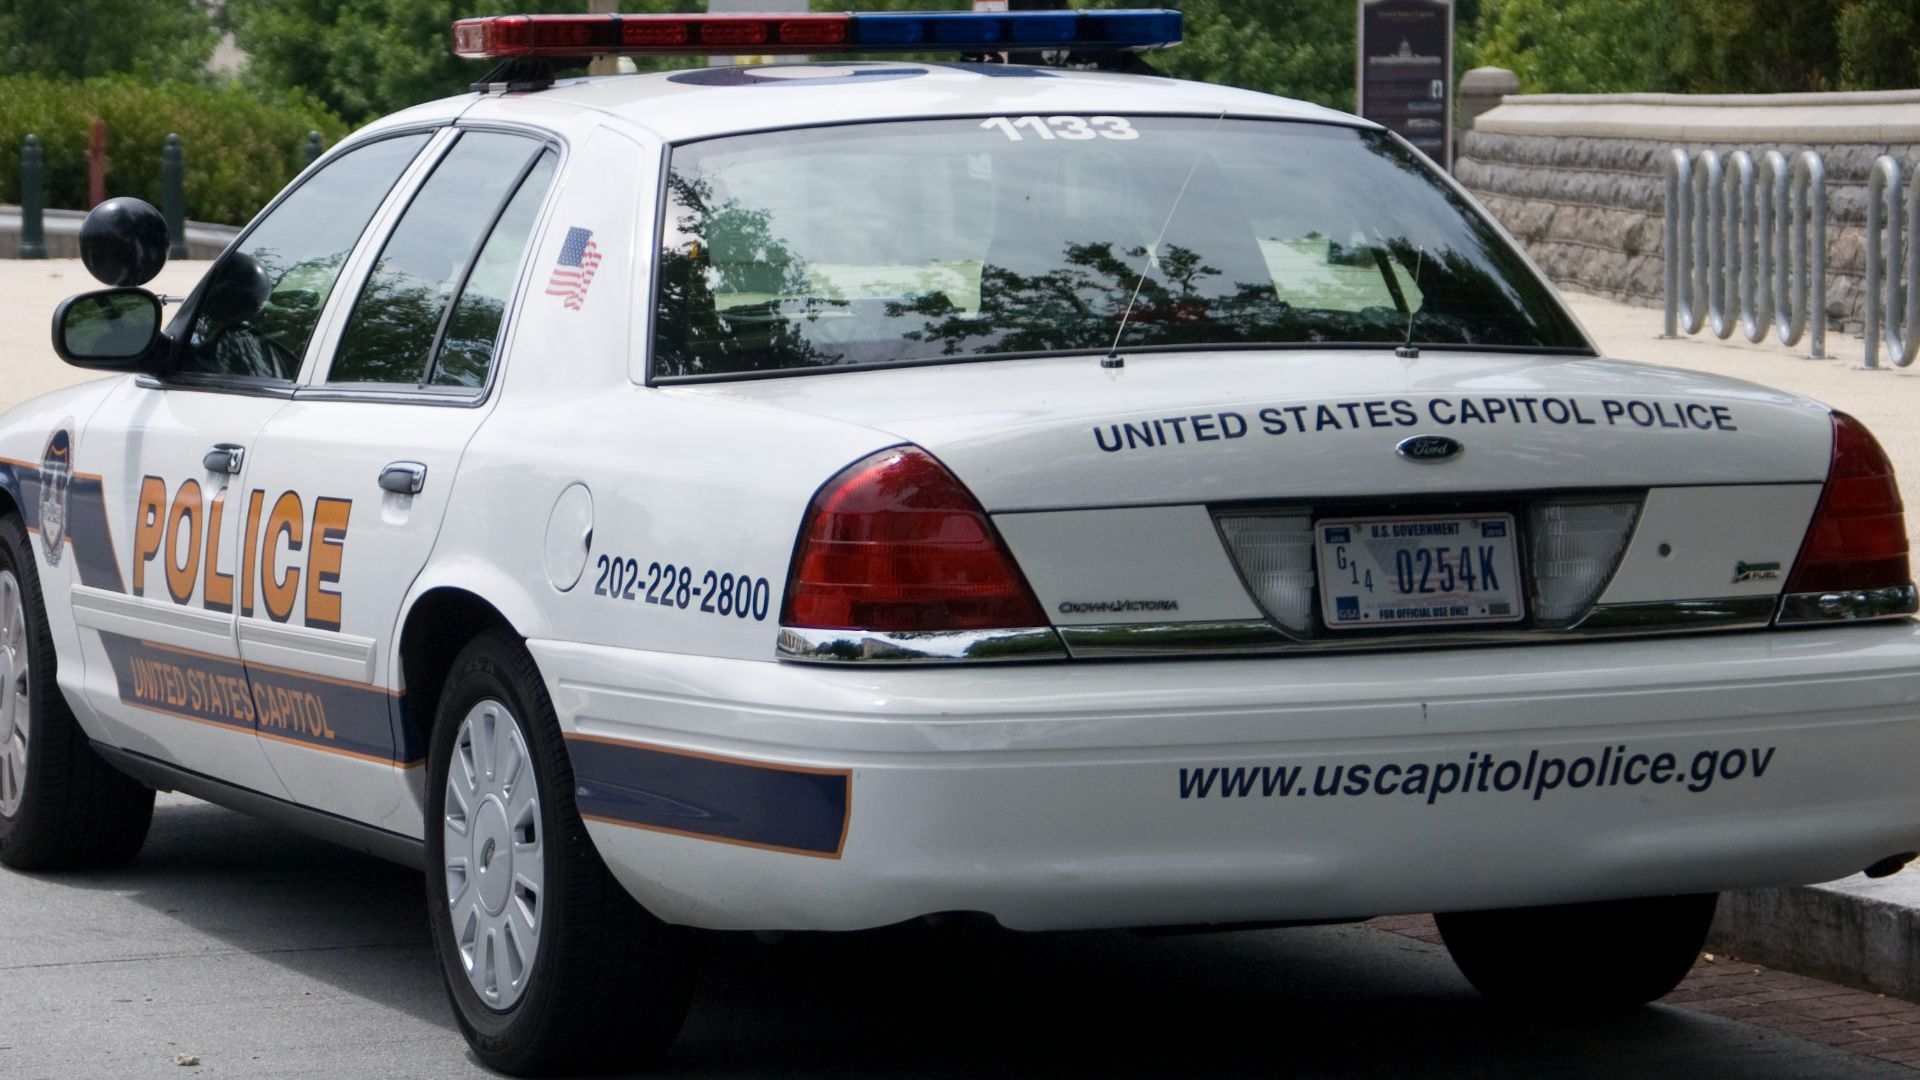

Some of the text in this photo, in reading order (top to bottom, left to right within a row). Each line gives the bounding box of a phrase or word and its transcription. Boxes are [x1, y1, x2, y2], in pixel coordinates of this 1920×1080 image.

[979, 115, 1140, 141] 1133
[1093, 397, 1738, 452] UNITED STATES CAPITOL POLICE
[1413, 439, 1448, 456] Ford
[133, 475, 353, 632] POLICE
[1371, 522, 1461, 538] U.S. GOVERNMENT
[594, 554, 770, 621] 202-228-2800
[1396, 545, 1500, 594] 0254K
[1058, 600, 1179, 614] CROWN VICTORIA
[1379, 606, 1469, 619] FOR OFFICIAL USE ONLY
[130, 656, 336, 739] UNITED STATES CAPITOL
[1179, 745, 1777, 805] www.uscapitolpolice.gov
